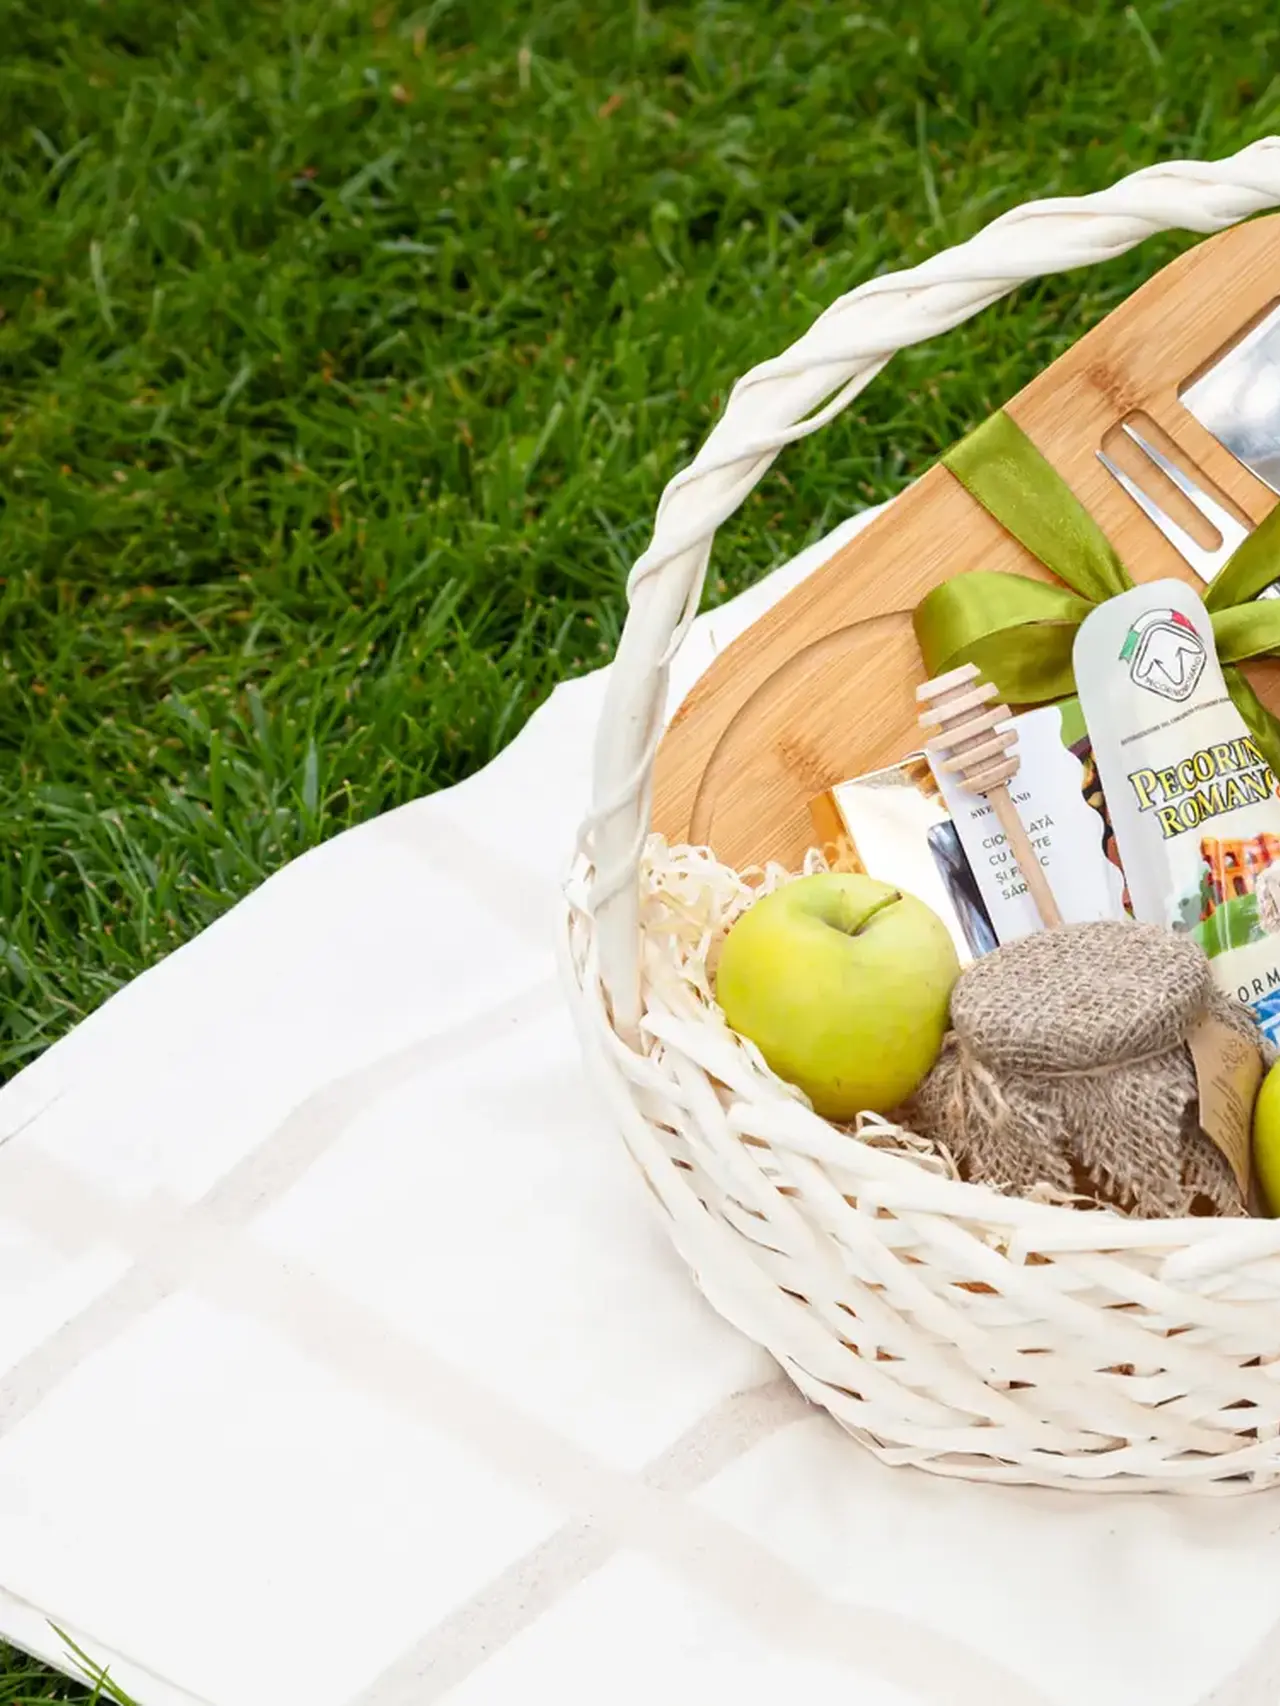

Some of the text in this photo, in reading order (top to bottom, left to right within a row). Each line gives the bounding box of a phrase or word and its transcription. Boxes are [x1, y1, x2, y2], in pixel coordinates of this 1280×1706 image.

[1128, 733, 1268, 812] PECORIN
[982, 814, 1055, 850] CIOATĂ
[989, 851, 1007, 867] CU
